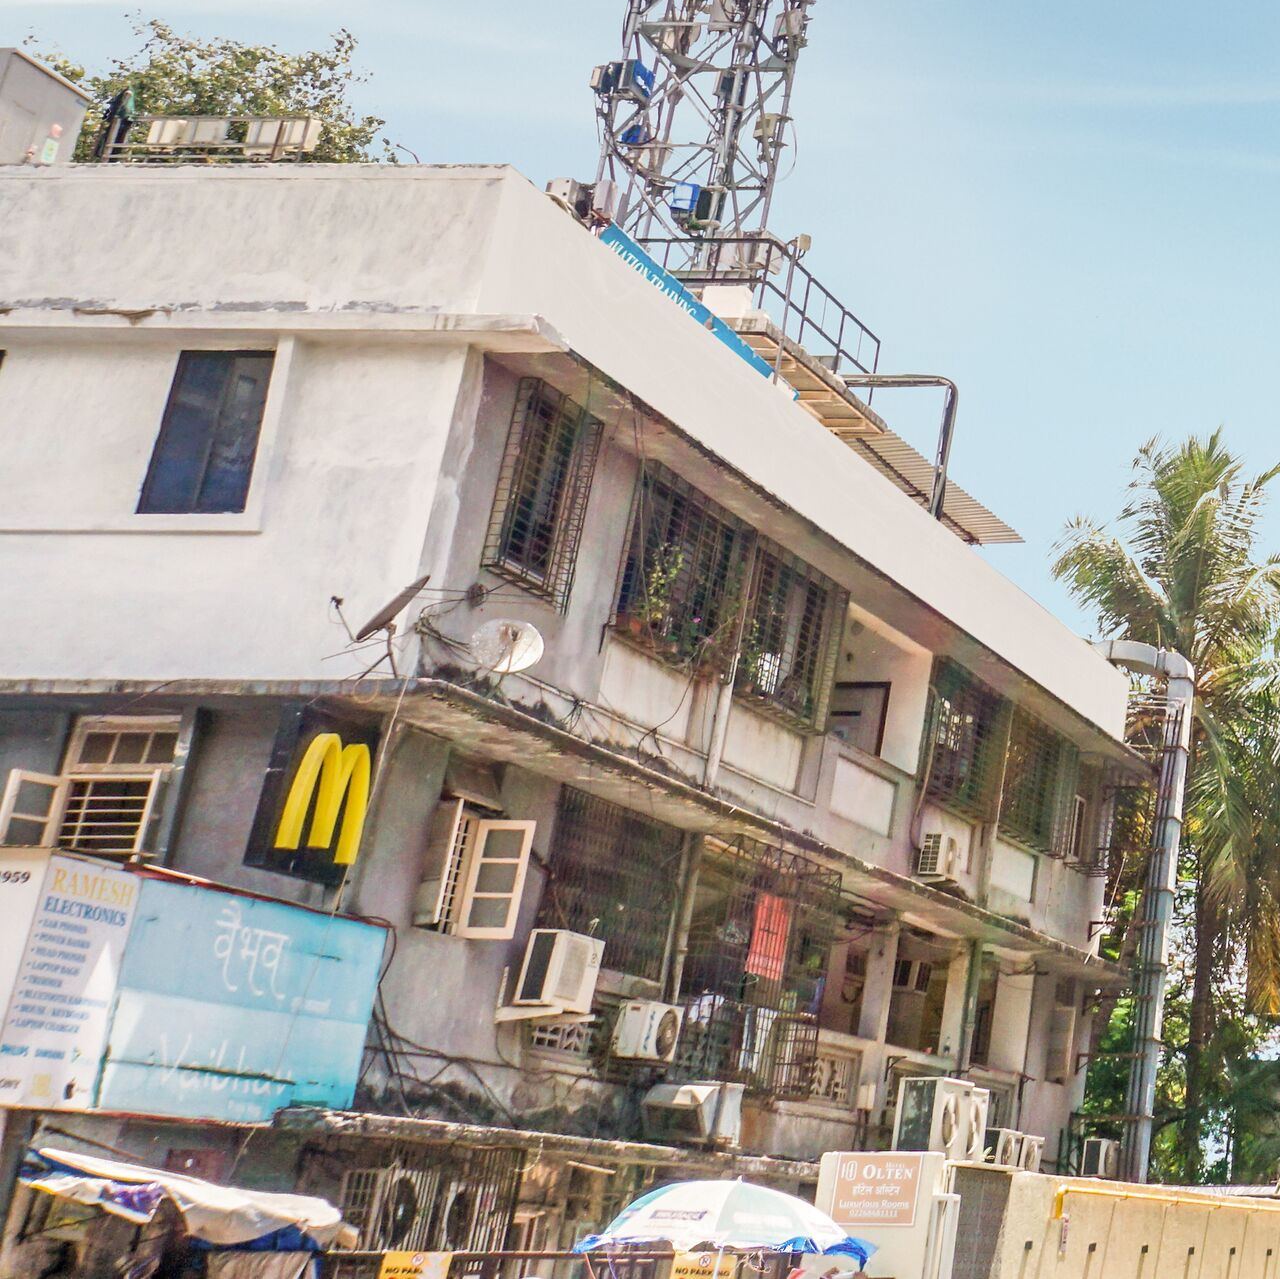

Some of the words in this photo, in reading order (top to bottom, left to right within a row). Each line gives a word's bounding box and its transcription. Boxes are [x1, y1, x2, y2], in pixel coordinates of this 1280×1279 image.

[608, 239, 652, 282] AVIATION
[51, 867, 135, 907] RAMESH
[44, 896, 128, 927] ELECTRONICS
[863, 1164, 913, 1180] OLTEN
[690, 1268, 730, 1277] PARKNG
